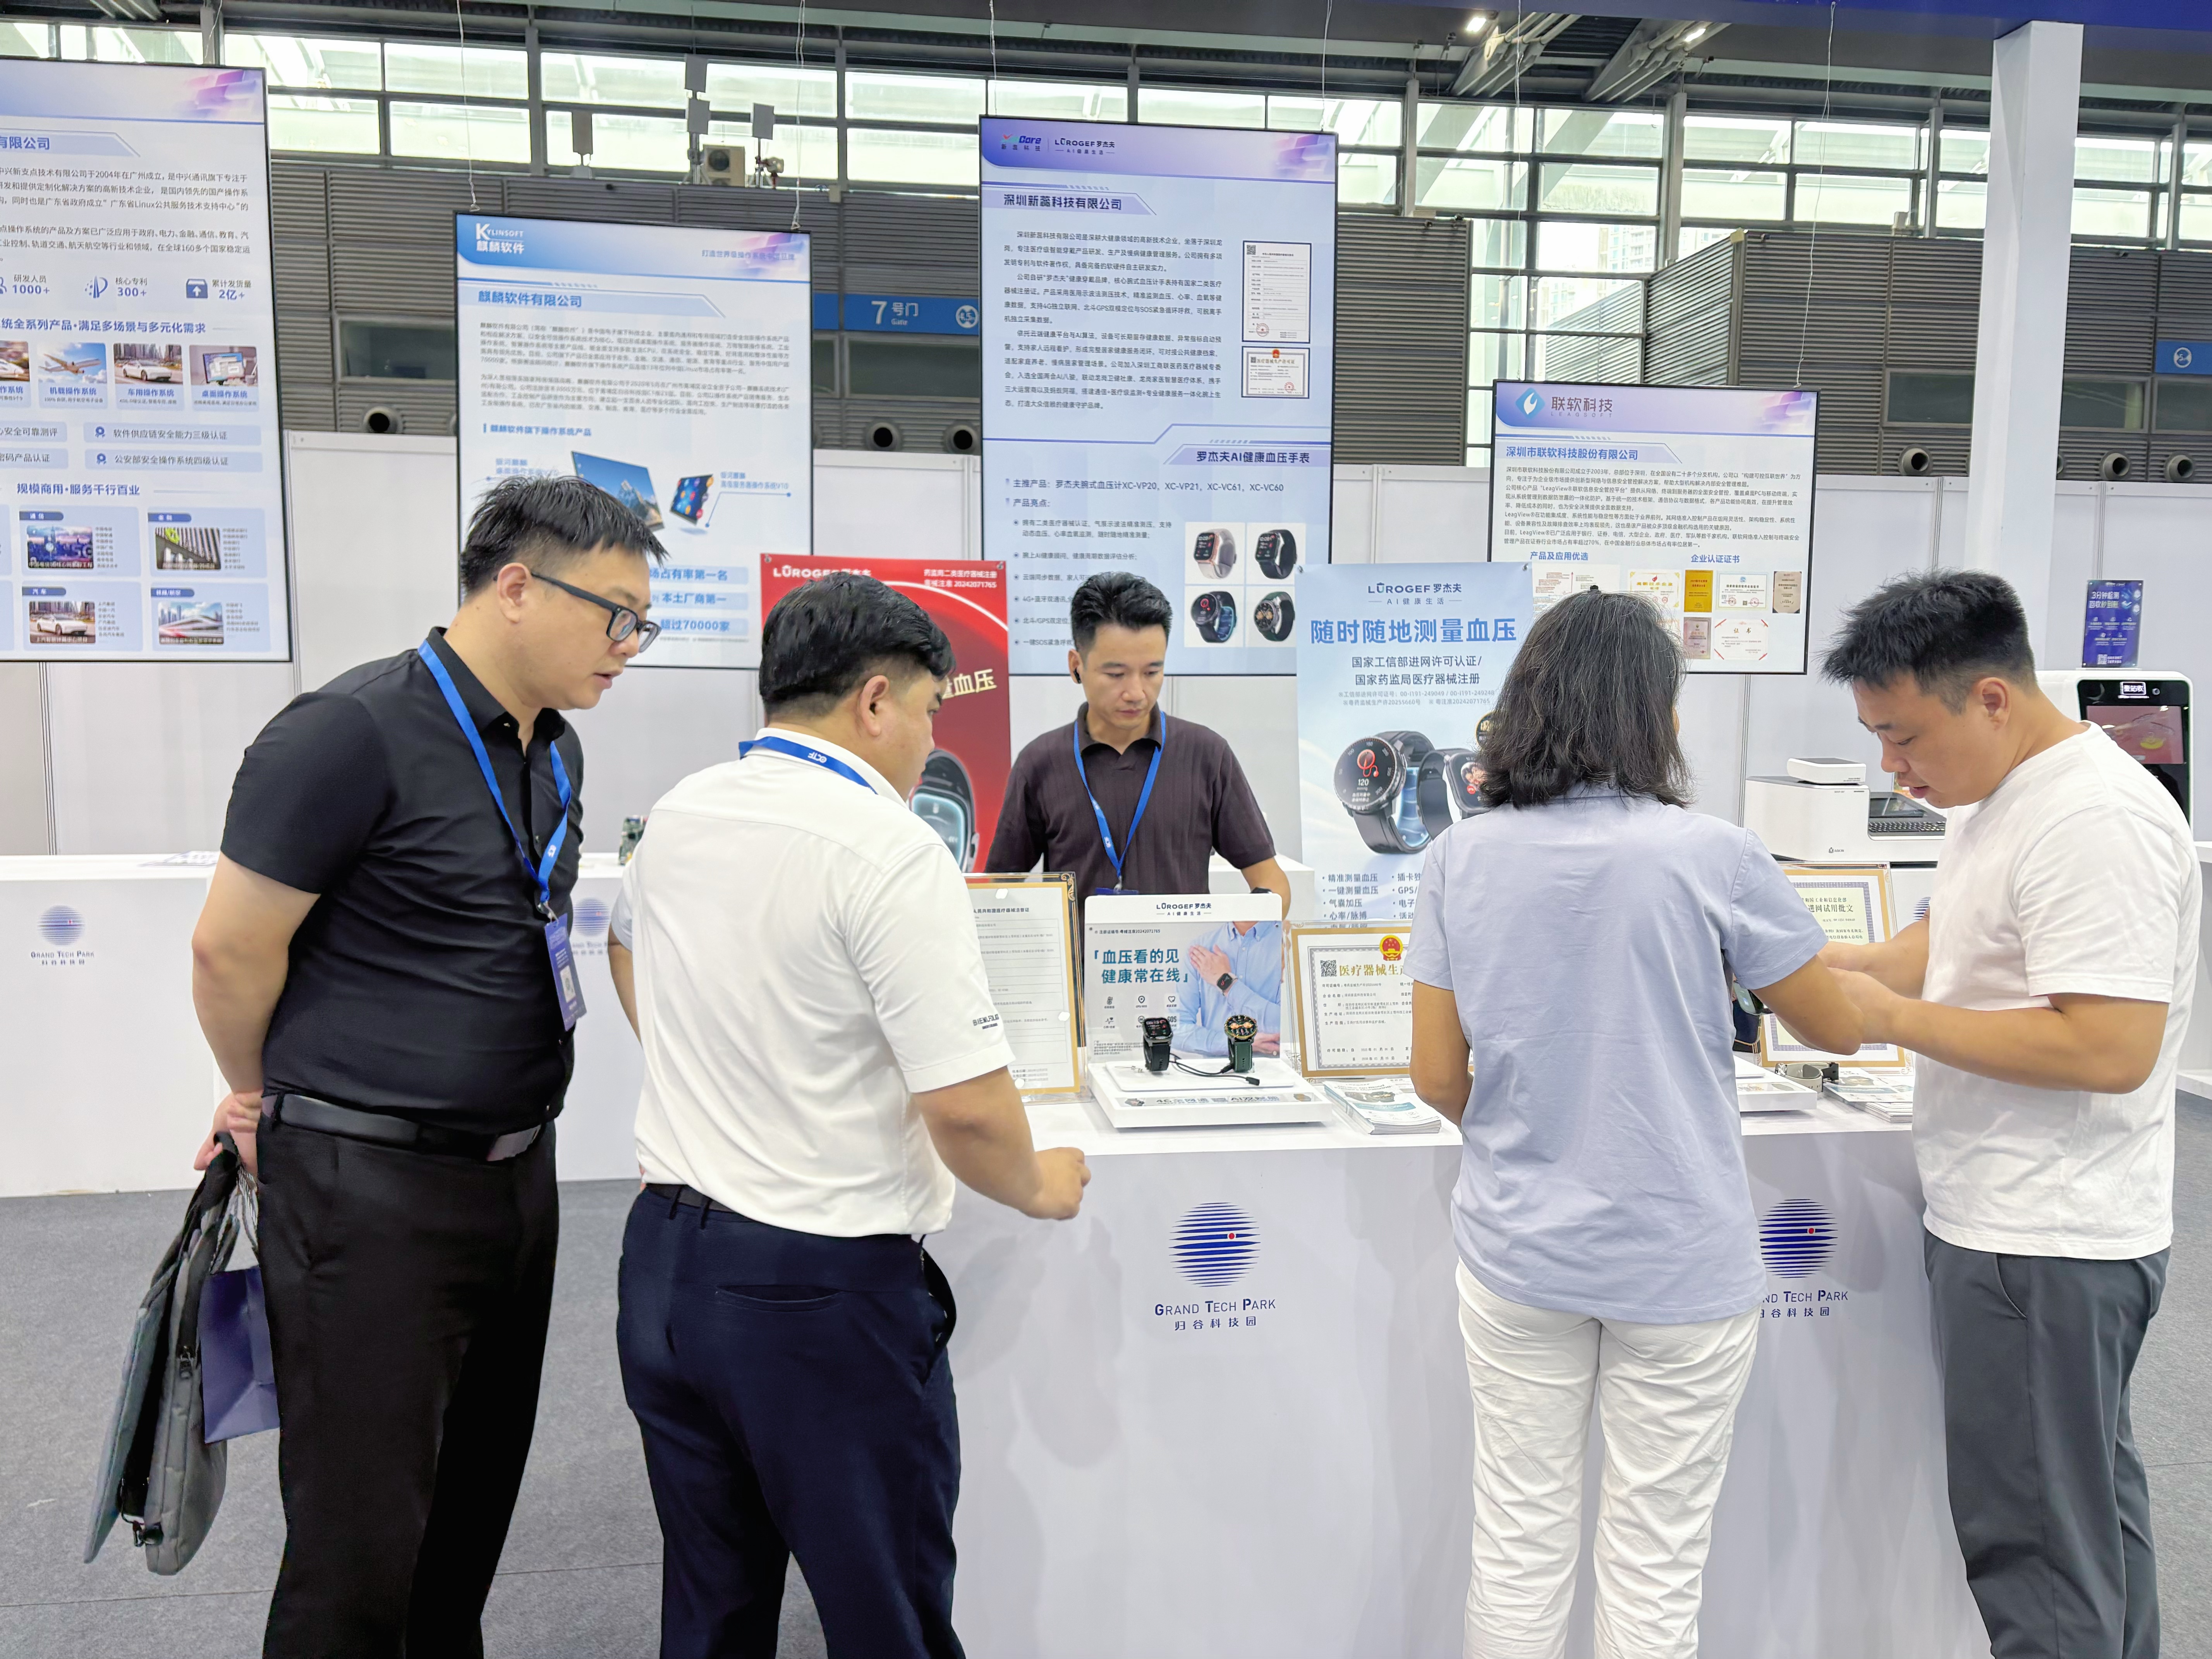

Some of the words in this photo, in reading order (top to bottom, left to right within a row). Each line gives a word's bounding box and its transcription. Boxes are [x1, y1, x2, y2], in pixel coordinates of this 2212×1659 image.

[475, 223, 524, 239] KYLINSOFT
[0, 239, 250, 254] 业控制、轨道交通、航天航空等行业和领域，在全球160多个国家稳定运
[476, 240, 525, 254] 麒麟软件
[14, 275, 46, 283] 研发人员
[115, 277, 148, 286] 核心专利
[212, 279, 251, 289] 累计发货量
[12, 285, 50, 295] 1000+
[117, 287, 147, 297] 300+
[219, 290, 245, 300] 2亿+
[478, 290, 582, 307] 麒麟软件有限公司
[871, 301, 888, 325] 7
[891, 302, 919, 317] 号门
[128, 388, 174, 397] 车用操作系统
[202, 390, 247, 399] 桌面操作系统
[1551, 396, 1613, 413] 联软科技
[113, 429, 228, 441] 软件供应链安全能力三级认证
[1196, 450, 1310, 464] 罗杰夫AI健康血压手表
[1506, 446, 1638, 460] 深圳市联软科技股份有限公司
[1530, 551, 1589, 561] 产品及应用优选
[1691, 554, 1740, 564] 企业认证证书
[954, 580, 997, 588] 20242071765
[1433, 583, 1462, 593] 罗杰夫
[661, 619, 730, 632] 超过70000家
[1310, 618, 1517, 644] 随时随地测量血压
[1352, 656, 1482, 668] 国家工信部进网许可认证/
[1355, 673, 1480, 685] 国家药监局医疗器械注册
[1328, 874, 1378, 882] 精准测量血压
[1328, 886, 1379, 895] 一键测量血压
[1329, 899, 1362, 908] 气囊加压
[1808, 904, 1853, 912] 进网试用批文
[1330, 911, 1367, 920] 心率/脉搏
[1783, 1291, 1812, 1302] TECH
[1818, 1290, 1848, 1301] PARK
[1155, 1304, 1199, 1316] GRAND
[1205, 1300, 1237, 1313] TECH
[1243, 1298, 1276, 1311] PARK
[1175, 1316, 1256, 1331] 归谷科技园
